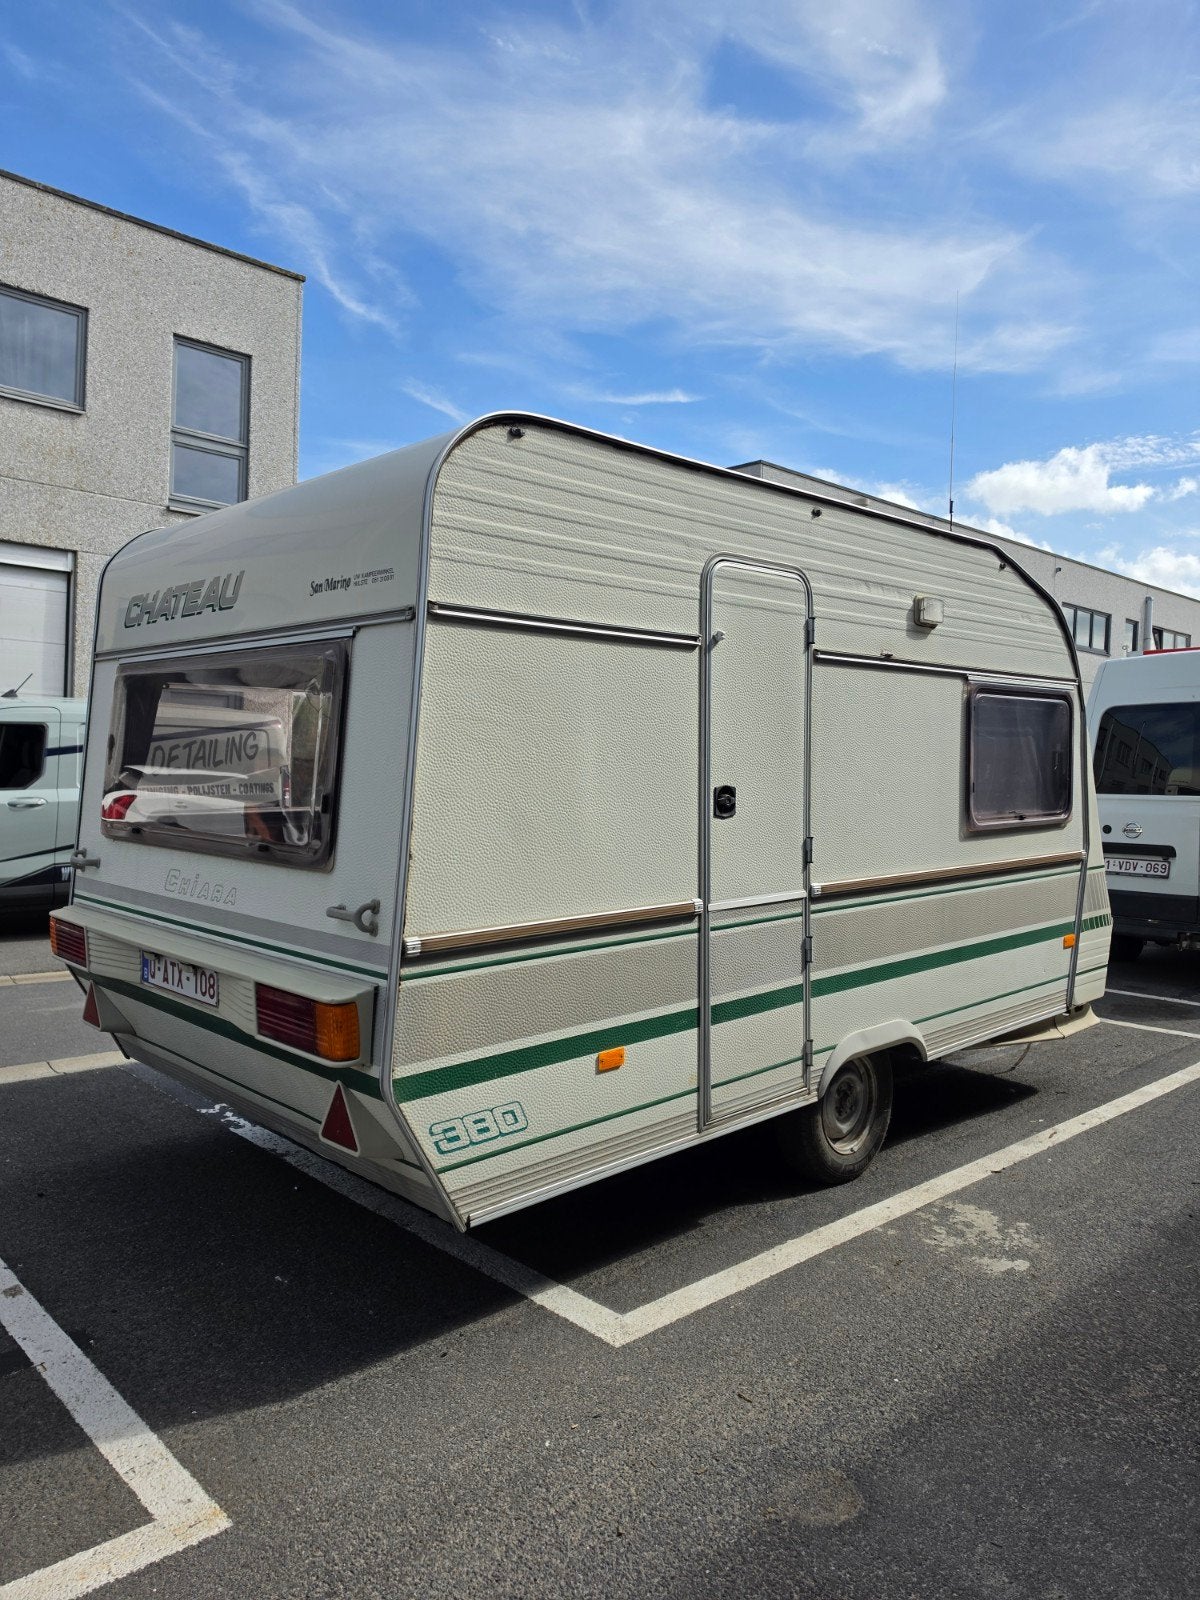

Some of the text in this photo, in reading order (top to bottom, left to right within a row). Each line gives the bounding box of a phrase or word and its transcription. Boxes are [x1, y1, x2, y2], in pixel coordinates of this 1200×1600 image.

[124, 570, 246, 628] CHATEAU
[324, 575, 351, 591] Marino
[151, 731, 259, 776] DETAILING
[238, 782, 275, 795] COATINGS
[428, 1101, 529, 1155] 380
